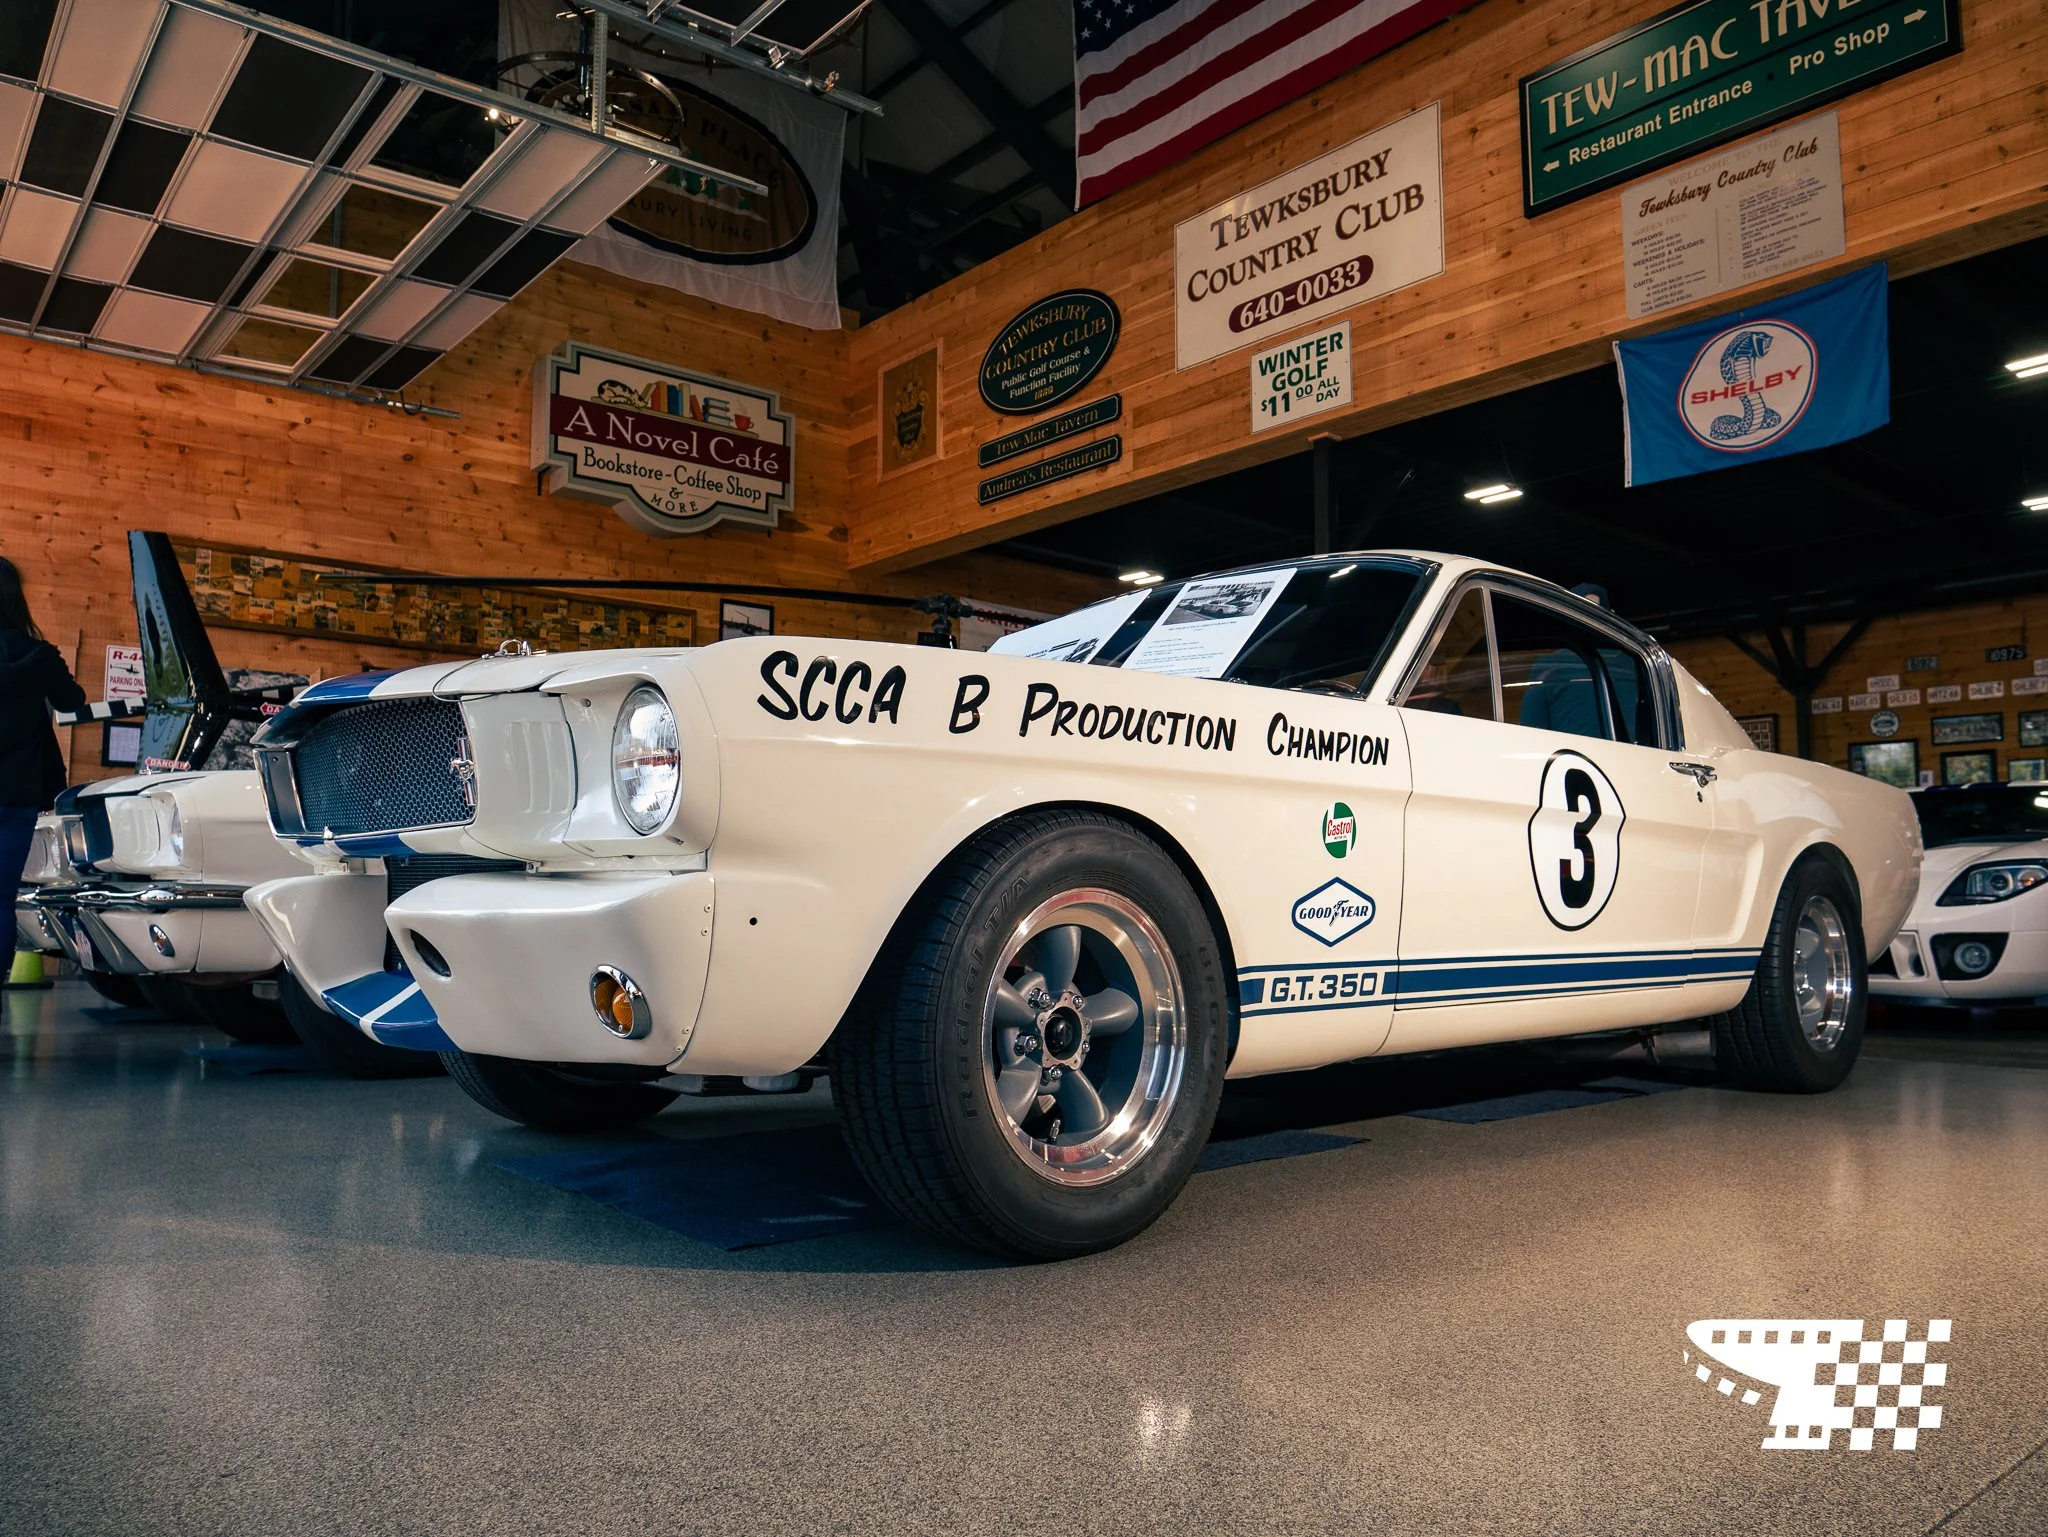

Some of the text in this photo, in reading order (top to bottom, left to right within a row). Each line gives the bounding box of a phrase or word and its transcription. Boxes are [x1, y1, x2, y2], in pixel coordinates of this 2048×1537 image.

[1540, 17, 1738, 135] TEW-MAC
[1568, 22, 1890, 165] Restaurant Entrance Pro Shop
[1210, 147, 1392, 251] TEWKSBURY
[1639, 182, 1711, 218] Tewksbury
[1717, 158, 1777, 188] Country
[1783, 137, 1818, 164] Club
[688, 212, 752, 242] LIVING
[1187, 183, 1425, 302] COUNTRY CLUB
[1239, 260, 1361, 329] 640-0033
[985, 317, 1106, 380] COUNTRY CLUB
[999, 304, 1092, 355] TEWKSBURY
[1258, 331, 1343, 377] WINTER
[1001, 346, 1091, 390] Public Golf Course &
[1009, 363, 1081, 399] Function Facility
[1272, 357, 1328, 392] GOLF
[1317, 376, 1339, 391] ALL
[1691, 364, 1804, 404] SHELBY
[1316, 387, 1340, 403] DAY
[563, 405, 780, 475] A Novel Café
[995, 441, 1019, 456] Tew
[1053, 408, 1099, 435] Tavern
[583, 446, 663, 480] Bookstore
[674, 464, 723, 493] Coffee
[726, 475, 762, 503] Shop
[669, 487, 683, 499] &
[983, 443, 1113, 498] Andrea's Restaurant
[650, 493, 699, 513] MORE
[109, 675, 133, 686] PARKING
[756, 650, 1390, 766] SCCA B PRODUCTION CHAMPION
[1327, 819, 1353, 837] Castrol
[1559, 768, 1602, 909] 3
[955, 945, 985, 1121] Radial
